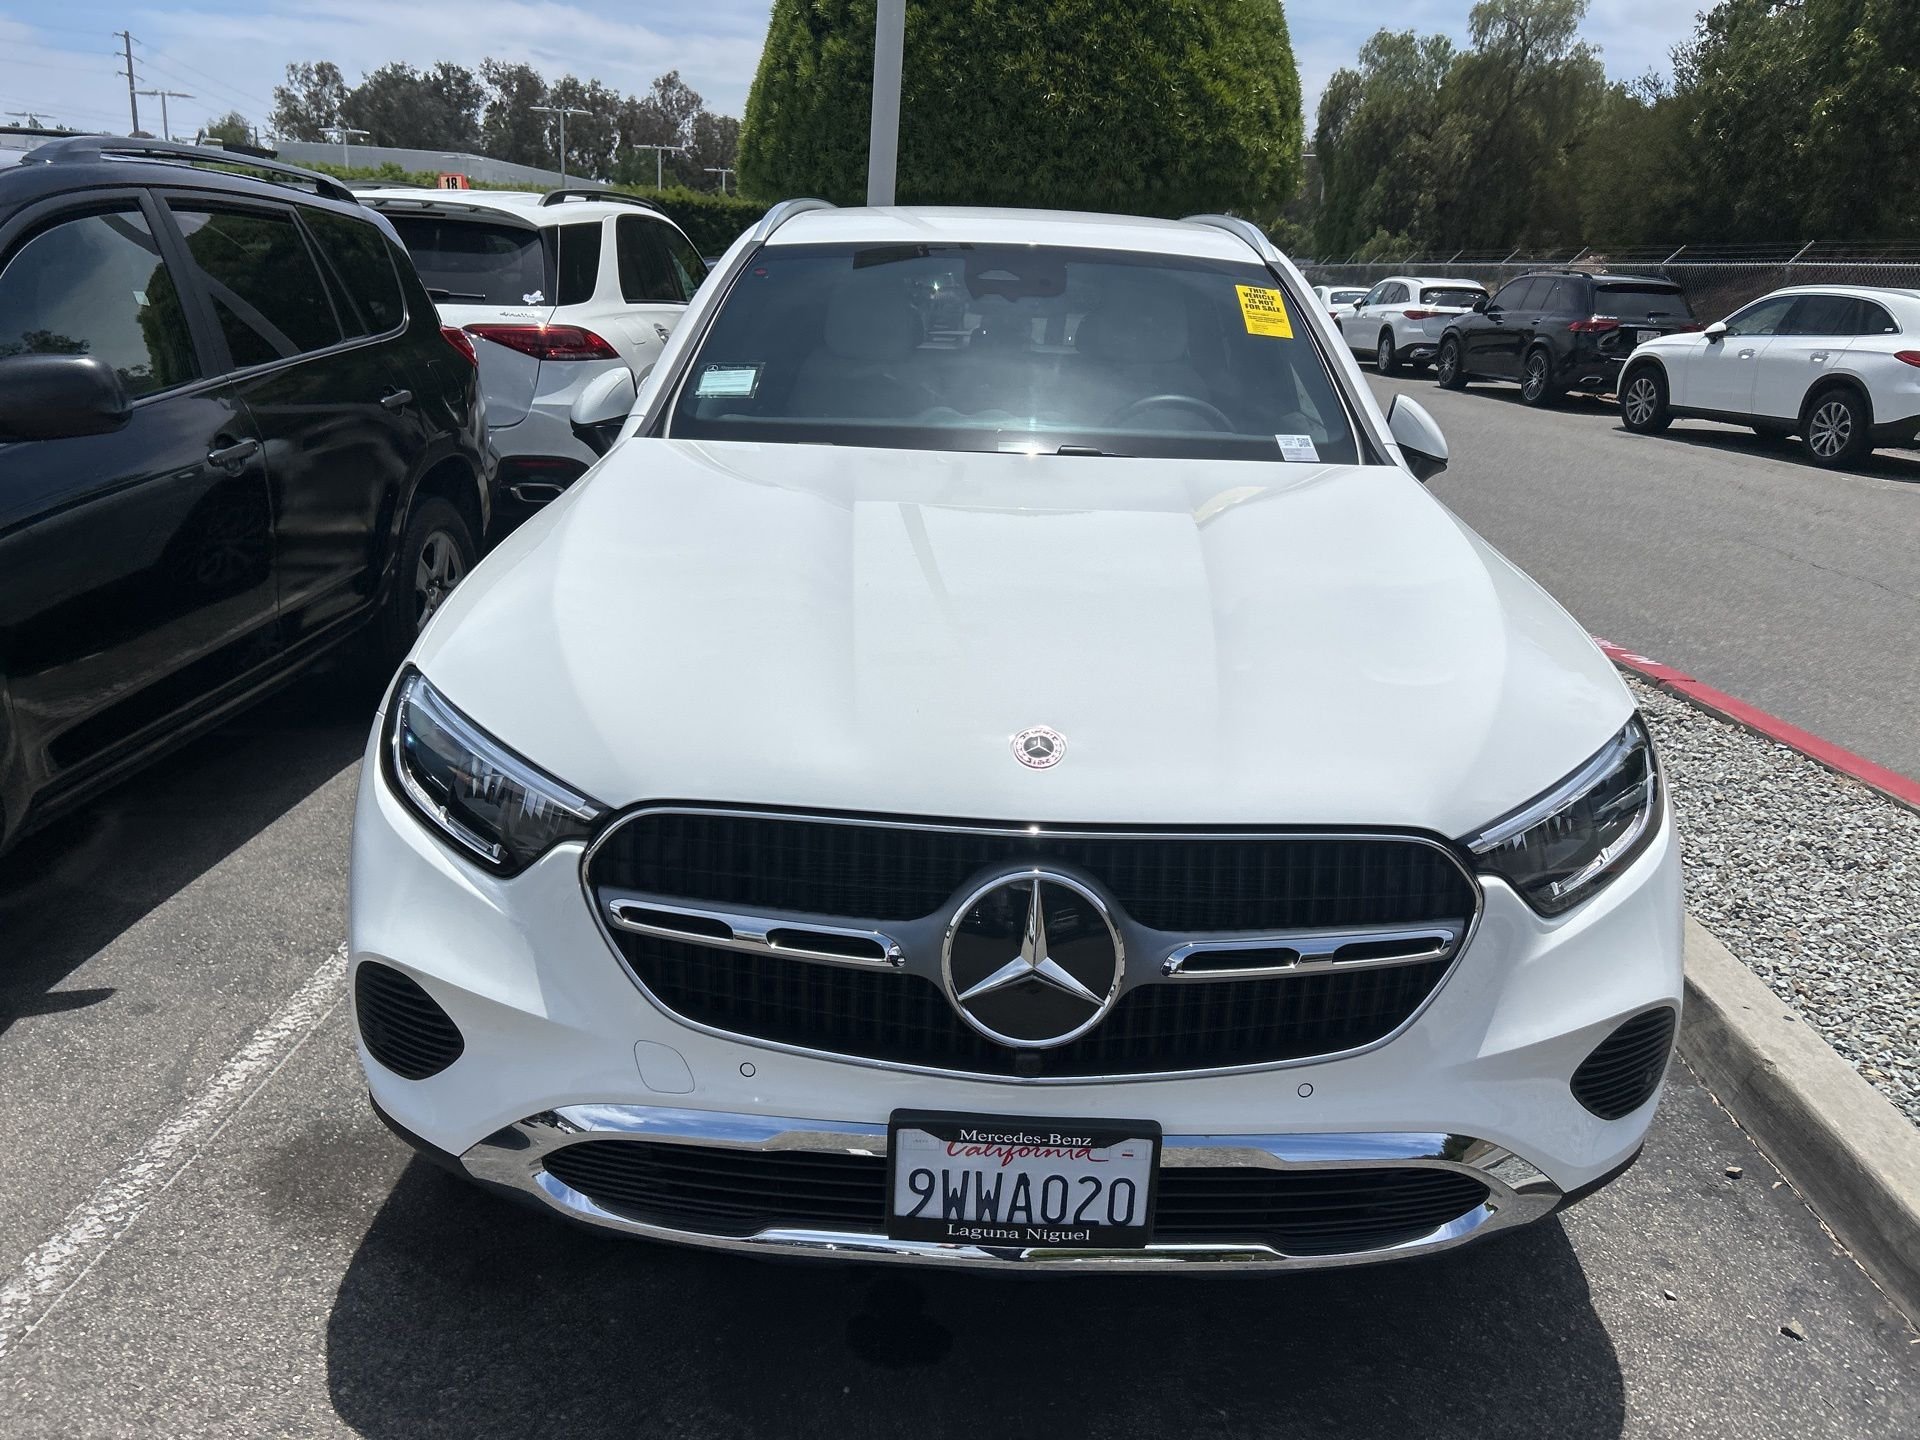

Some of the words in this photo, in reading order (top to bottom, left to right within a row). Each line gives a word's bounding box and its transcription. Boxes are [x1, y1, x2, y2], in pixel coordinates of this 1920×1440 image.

[446, 177, 458, 189] 18
[1243, 292, 1275, 300] VEHICLE
[959, 1129, 1093, 1147] Mercedes-Benz
[946, 1141, 1109, 1167] California
[907, 1168, 1136, 1226] 9WWA020
[946, 1224, 1020, 1240] Laguna
[1026, 1228, 1091, 1242] Niguel
